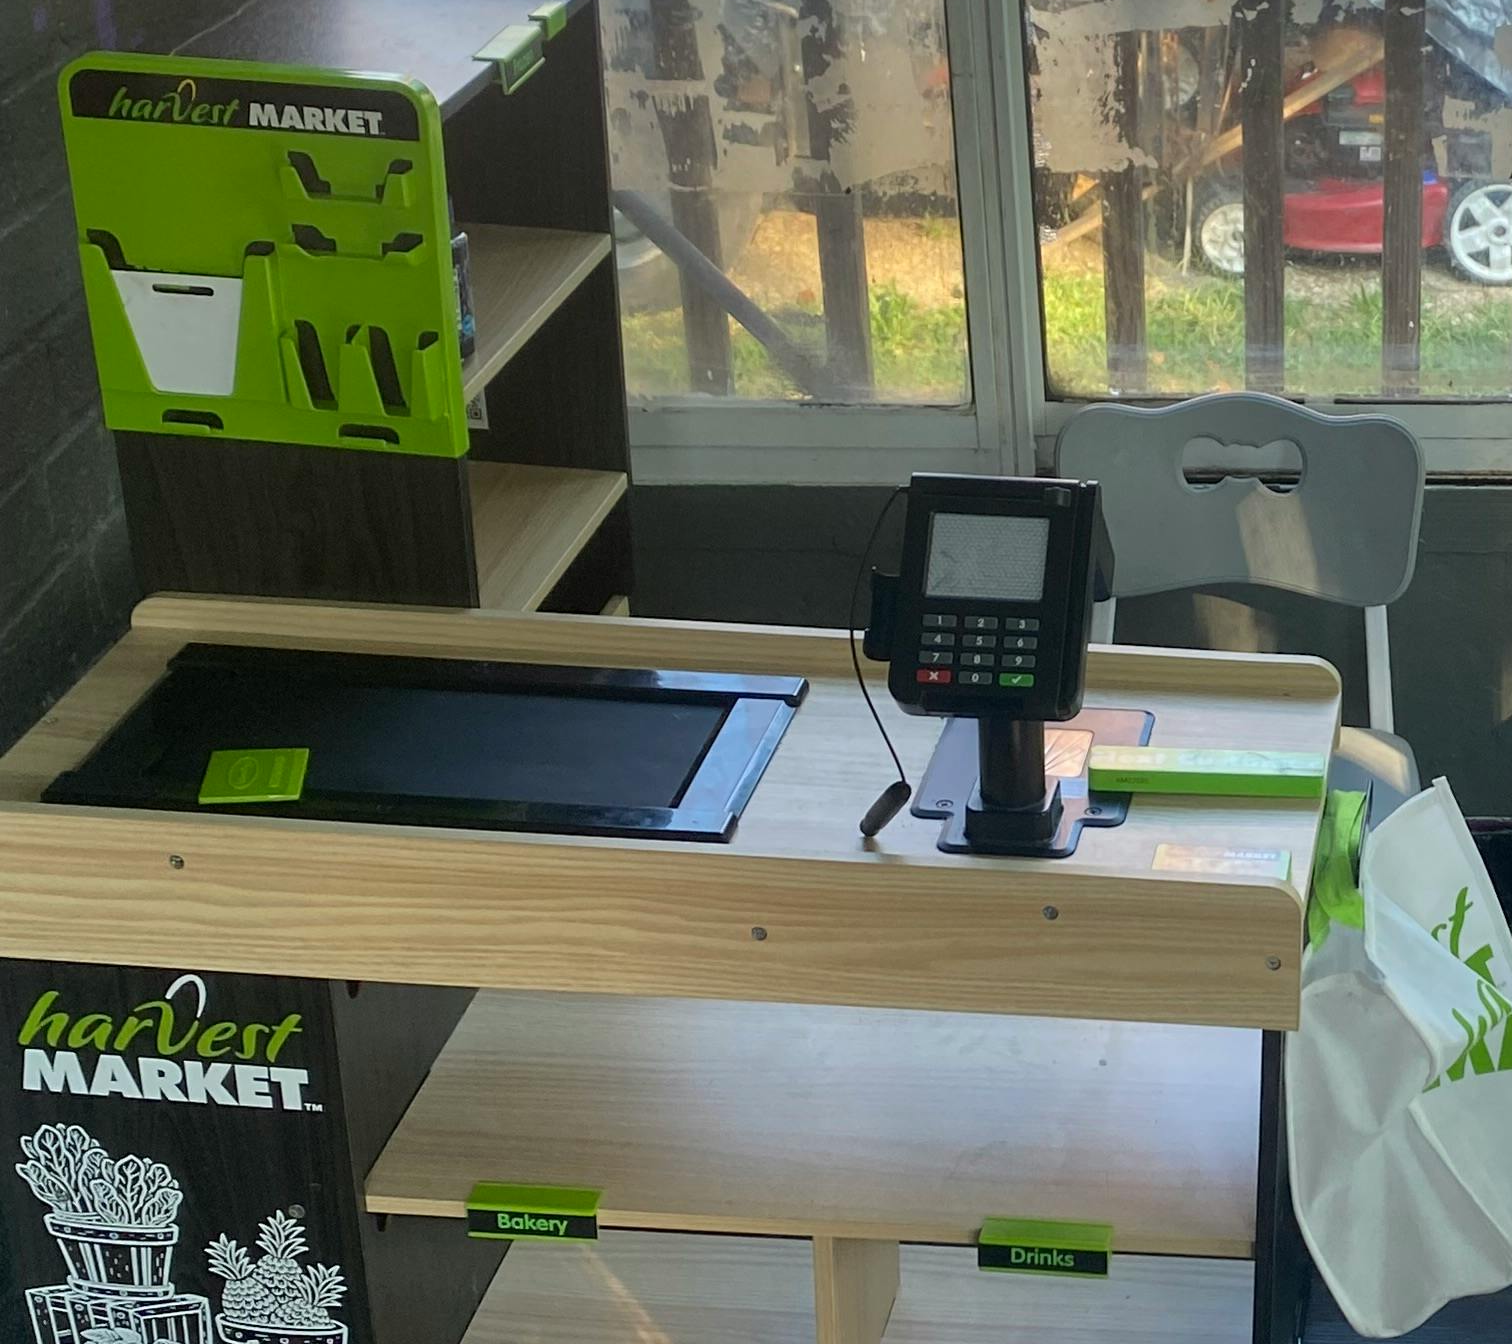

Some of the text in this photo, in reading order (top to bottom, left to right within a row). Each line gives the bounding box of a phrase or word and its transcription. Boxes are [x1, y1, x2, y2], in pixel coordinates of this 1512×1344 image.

[108, 78, 240, 127] harvest
[937, 615, 1026, 629] 1 2 3
[934, 634, 1024, 647] 4 5 6
[932, 652, 1023, 666] 7 8 9
[971, 673, 979, 683] 0
[18, 973, 303, 1063] harvest
[497, 1213, 568, 1236] Bakery
[1010, 1247, 1075, 1267] Drinks
